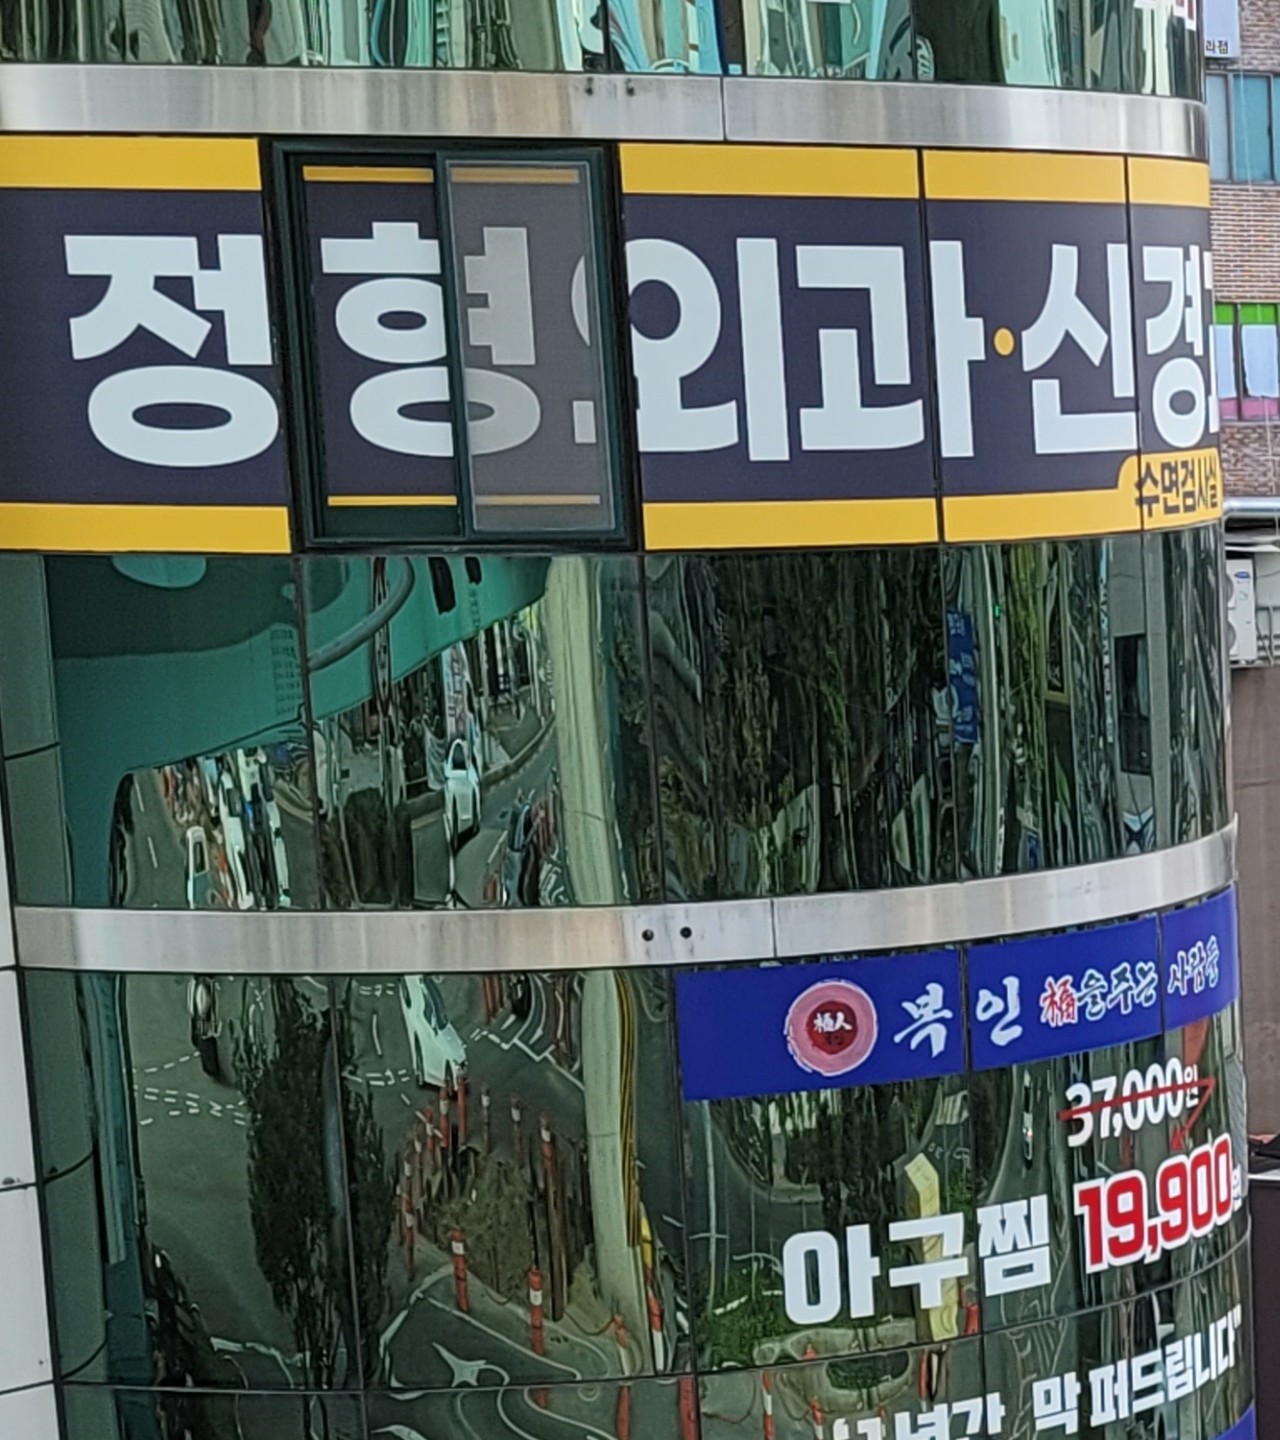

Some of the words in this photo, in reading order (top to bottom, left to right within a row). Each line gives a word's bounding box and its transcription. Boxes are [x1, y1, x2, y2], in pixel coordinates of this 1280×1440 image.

[1134, 455, 1218, 519] 수면검사실
[781, 1192, 1052, 1329] 아구찜
[1032, 1369, 1081, 1437] 막
